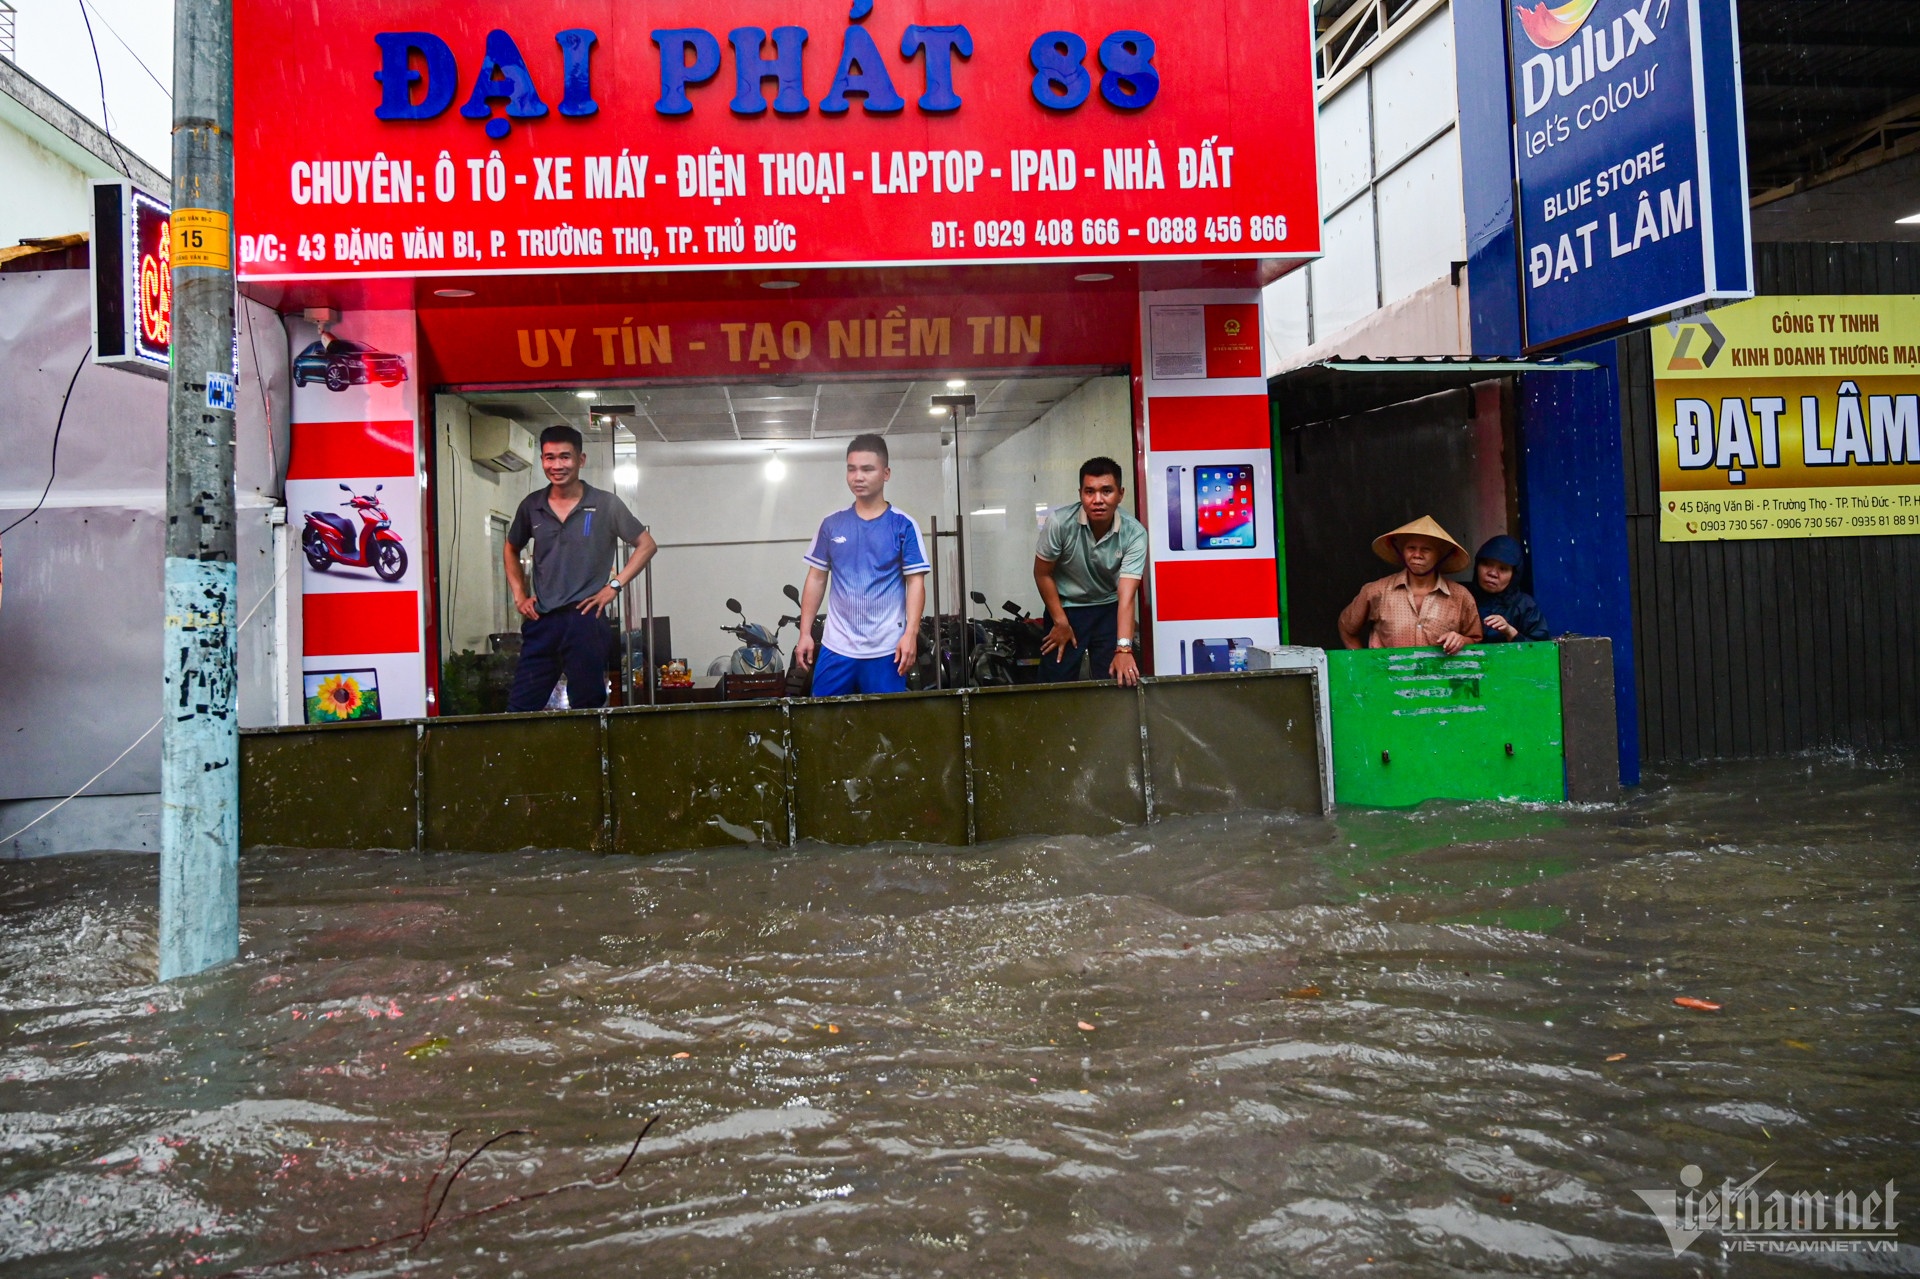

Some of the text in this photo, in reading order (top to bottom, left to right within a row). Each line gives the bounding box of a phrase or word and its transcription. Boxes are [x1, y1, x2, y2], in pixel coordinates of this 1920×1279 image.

[374, 0, 1159, 138] ĐẠI PHÁT 88
[1521, 0, 1656, 117] Dulux
[1525, 63, 1658, 158] let's colour
[292, 153, 424, 204] CHUYÊN:
[436, 151, 454, 202] Ô
[467, 150, 505, 201] TÔ
[533, 158, 572, 199] XE
[585, 149, 648, 198] MÁY
[677, 147, 745, 205] ĐIỆN
[759, 152, 845, 203] THOẠI
[872, 150, 983, 193] LAPTOP
[1011, 149, 1076, 191] IPAD
[1103, 140, 1164, 189] NHÀ
[1178, 136, 1233, 188] ĐẤT
[1543, 142, 1665, 221] BLUE STORE
[180, 230, 203, 248] 15
[240, 218, 796, 265] Đ/C: 43 ĐẶNG VĂN BI, P. TRƯỜNG THỌ, TP. THỦ ĐỨC
[931, 222, 964, 248] ĐT:
[974, 220, 1025, 247] 0929
[1035, 219, 1073, 245] 408
[1082, 219, 1119, 244] 666
[1147, 217, 1196, 243] 0888
[1205, 216, 1241, 242] 456
[1250, 215, 1286, 241] 866
[1529, 179, 1692, 288] ĐẠT LÂM
[516, 328, 576, 367] UY
[592, 317, 672, 365] TÍN
[721, 324, 810, 367] TẠO
[829, 311, 950, 357] NIỀM
[967, 317, 1040, 353] TIN
[1771, 311, 1880, 334] CÔNG TY TNHH
[1730, 347, 1770, 367] KINH
[1772, 346, 1826, 366] DOANH
[1828, 344, 1889, 365] THƯƠNG
[1673, 380, 1920, 484] ĐẠT LÂM
[1679, 501, 1693, 513] 45
[1696, 500, 1721, 515] Đặng
[1723, 500, 1742, 512] Văn
[1744, 499, 1754, 511] Bi
[1772, 498, 1807, 513] Trường
[1808, 498, 1827, 511] Thọ
[1850, 495, 1869, 508] Thủ
[1871, 495, 1890, 508] Đức
[1700, 520, 1726, 532] 0903
[1728, 519, 1747, 531] 730
[1749, 519, 1768, 530] 567
[1776, 518, 1802, 529] 0906
[1804, 517, 1823, 528] 730
[1825, 516, 1844, 528] 567
[1851, 516, 1877, 527] 0935
[1878, 515, 1890, 526] 81
[1893, 515, 1906, 526] 88
